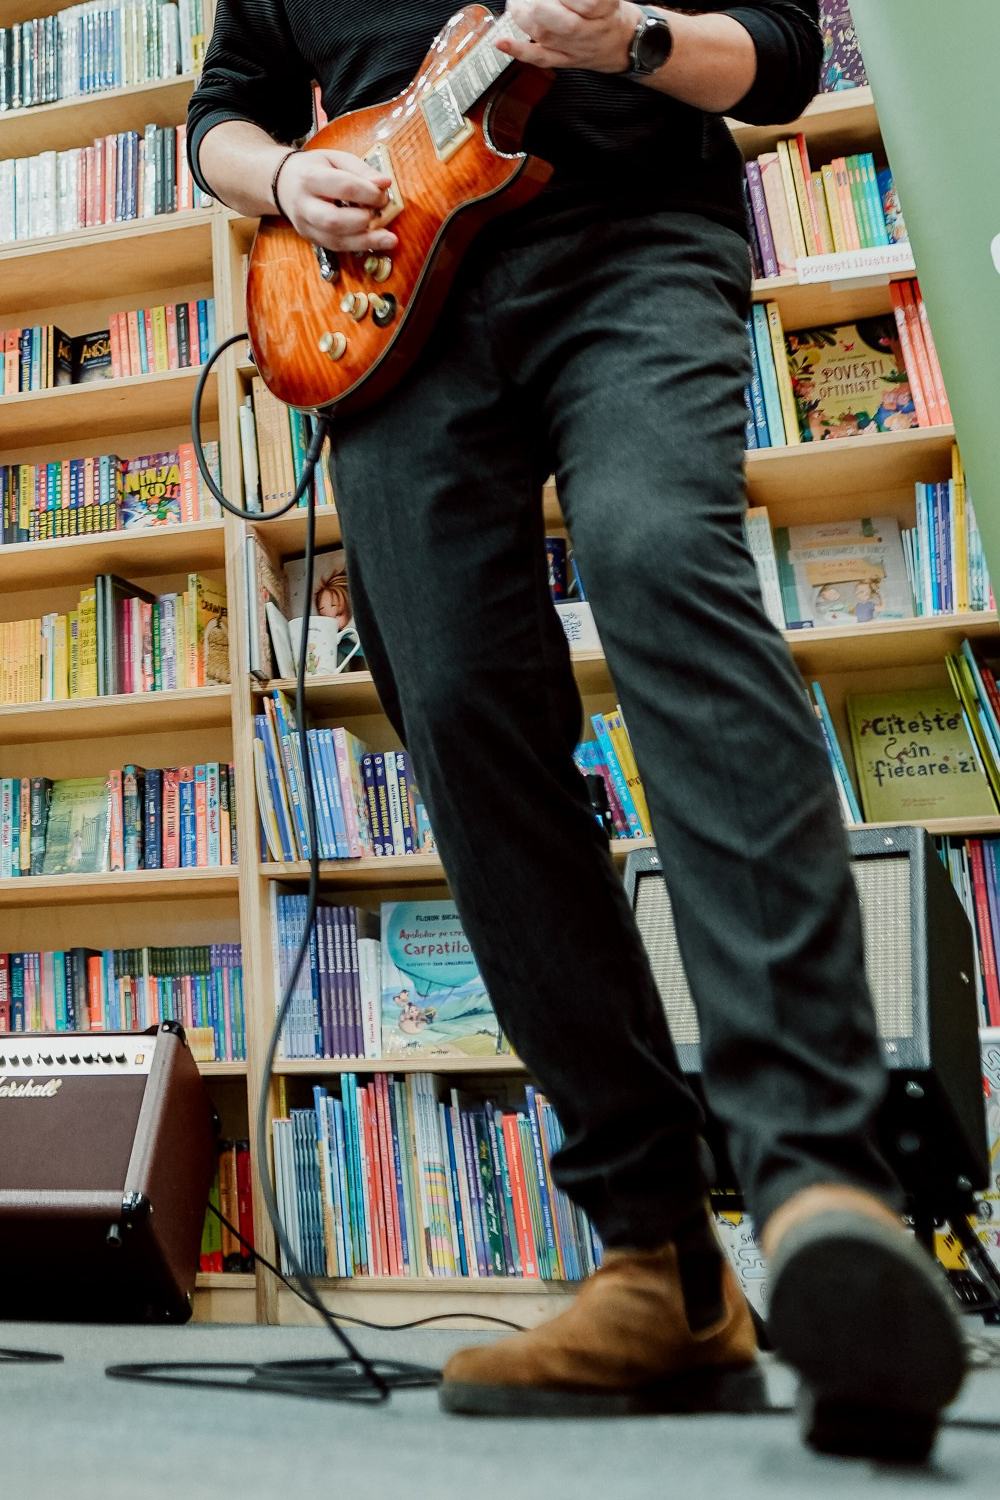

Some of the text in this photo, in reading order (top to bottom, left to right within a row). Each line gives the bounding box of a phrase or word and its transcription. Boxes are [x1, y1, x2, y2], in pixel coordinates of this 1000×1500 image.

[802, 259, 851, 278] povești
[820, 360, 885, 384] POVEȘTI
[819, 377, 881, 399] OPTIMISTE
[126, 463, 180, 493] NINJA
[871, 714, 961, 739] Citește
[873, 754, 979, 787] fiecare zi
